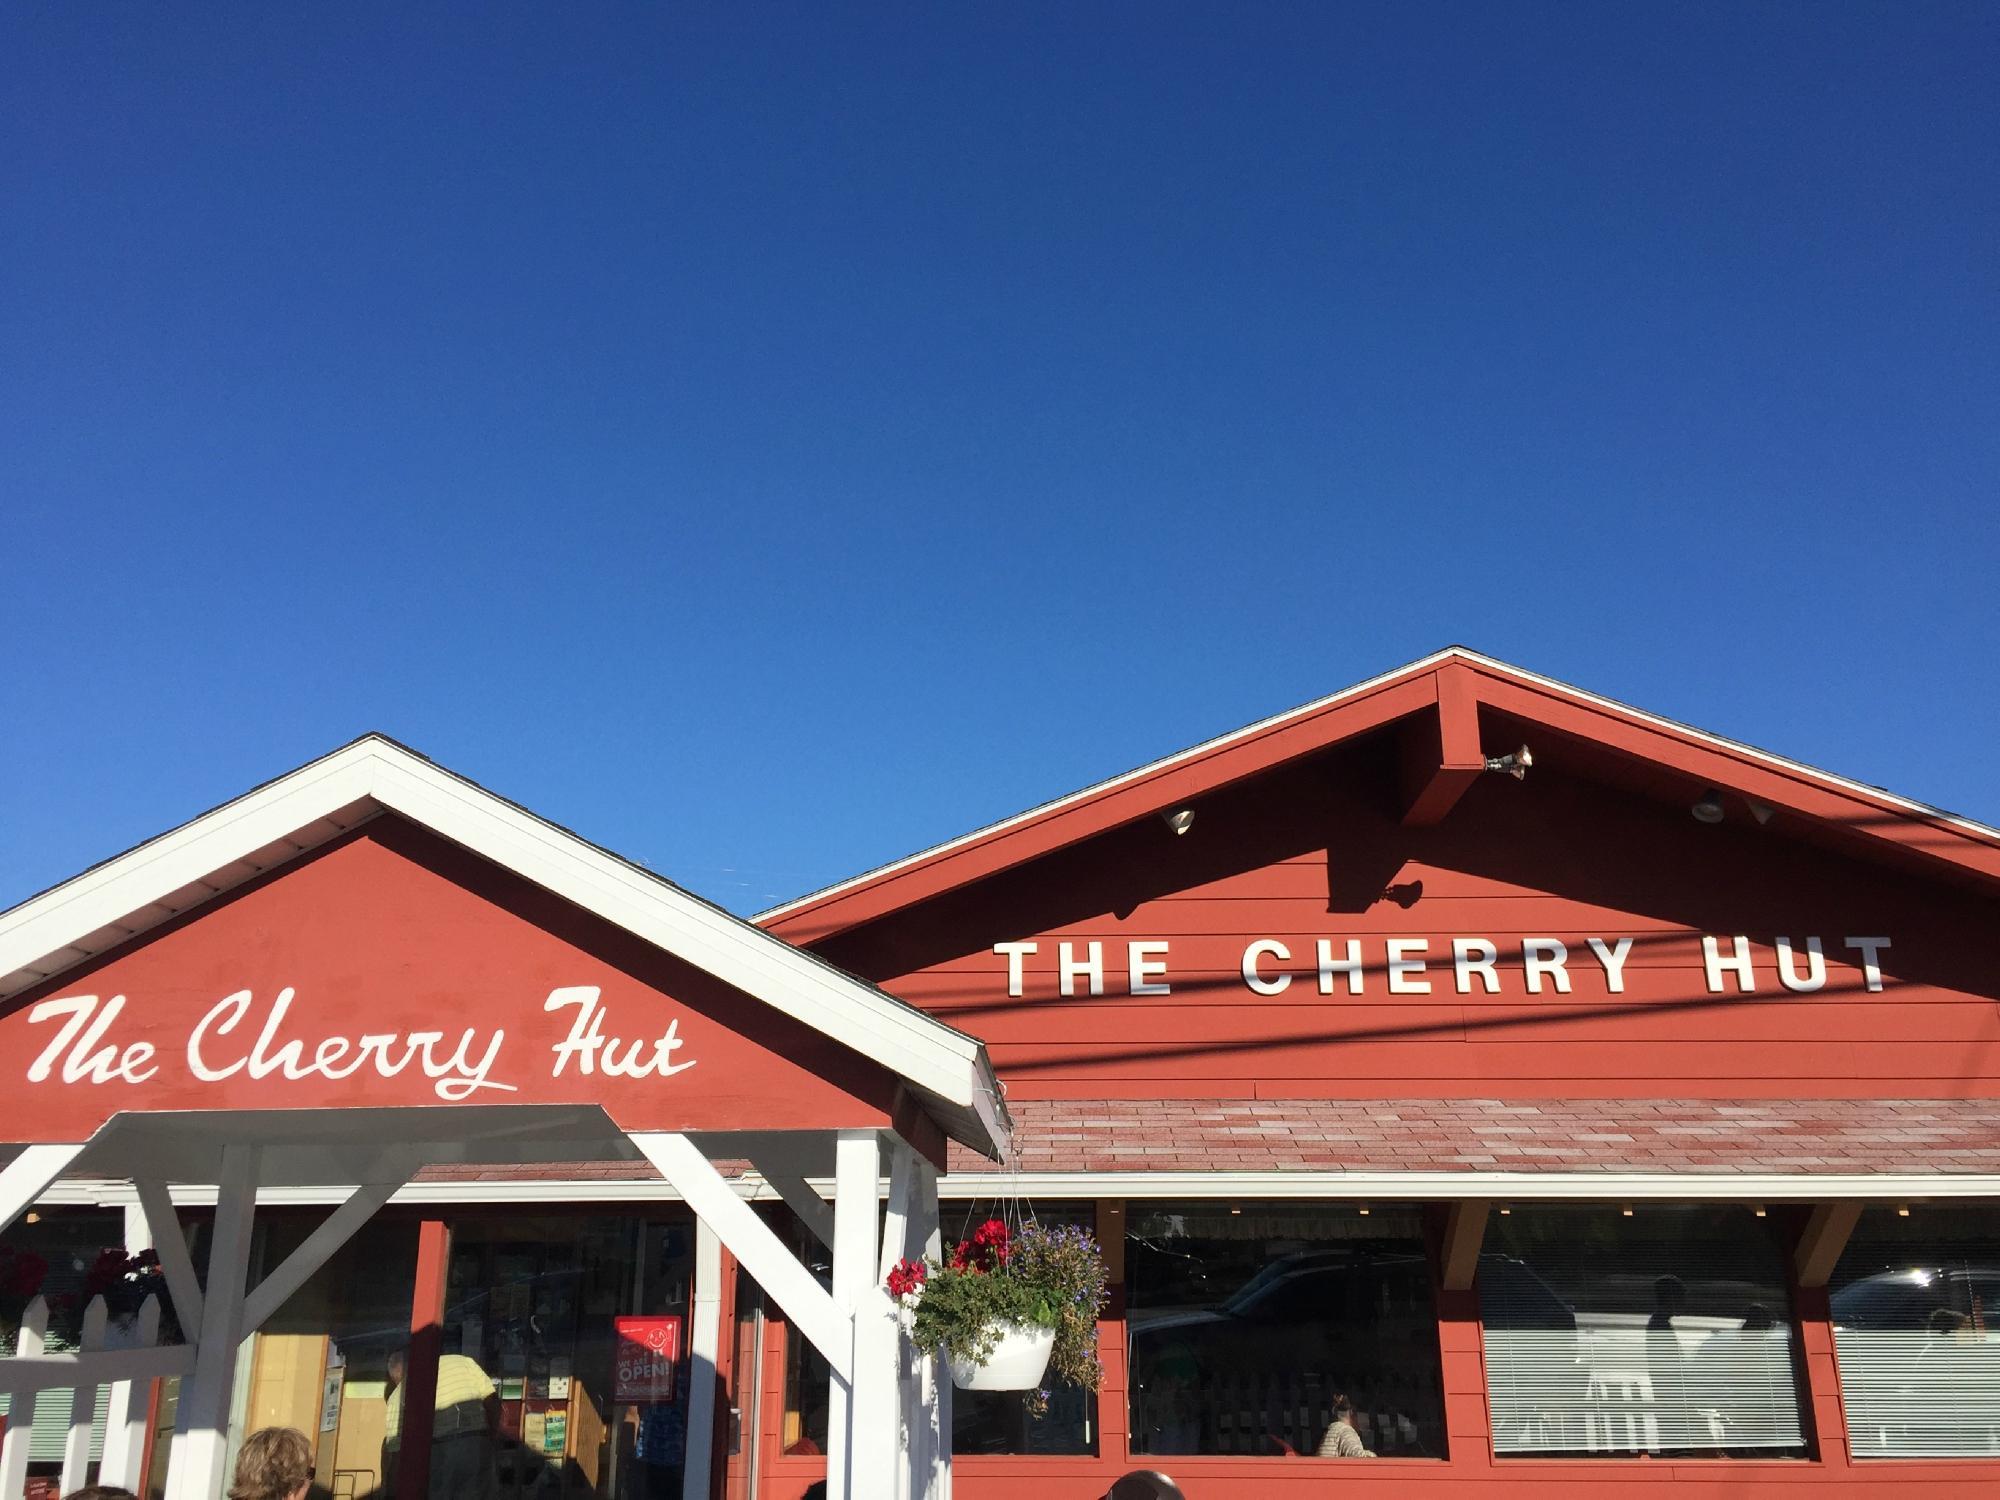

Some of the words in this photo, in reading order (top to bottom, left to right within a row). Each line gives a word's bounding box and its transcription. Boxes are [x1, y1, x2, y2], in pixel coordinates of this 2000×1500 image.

[994, 940, 1171, 996] THE
[1242, 938, 1634, 995] CHERRY
[1702, 936, 1892, 994] HUT
[27, 994, 160, 1084] The
[187, 987, 518, 1100] Cherry
[544, 986, 697, 1079] Hut
[619, 1362, 670, 1382] OPEN!
